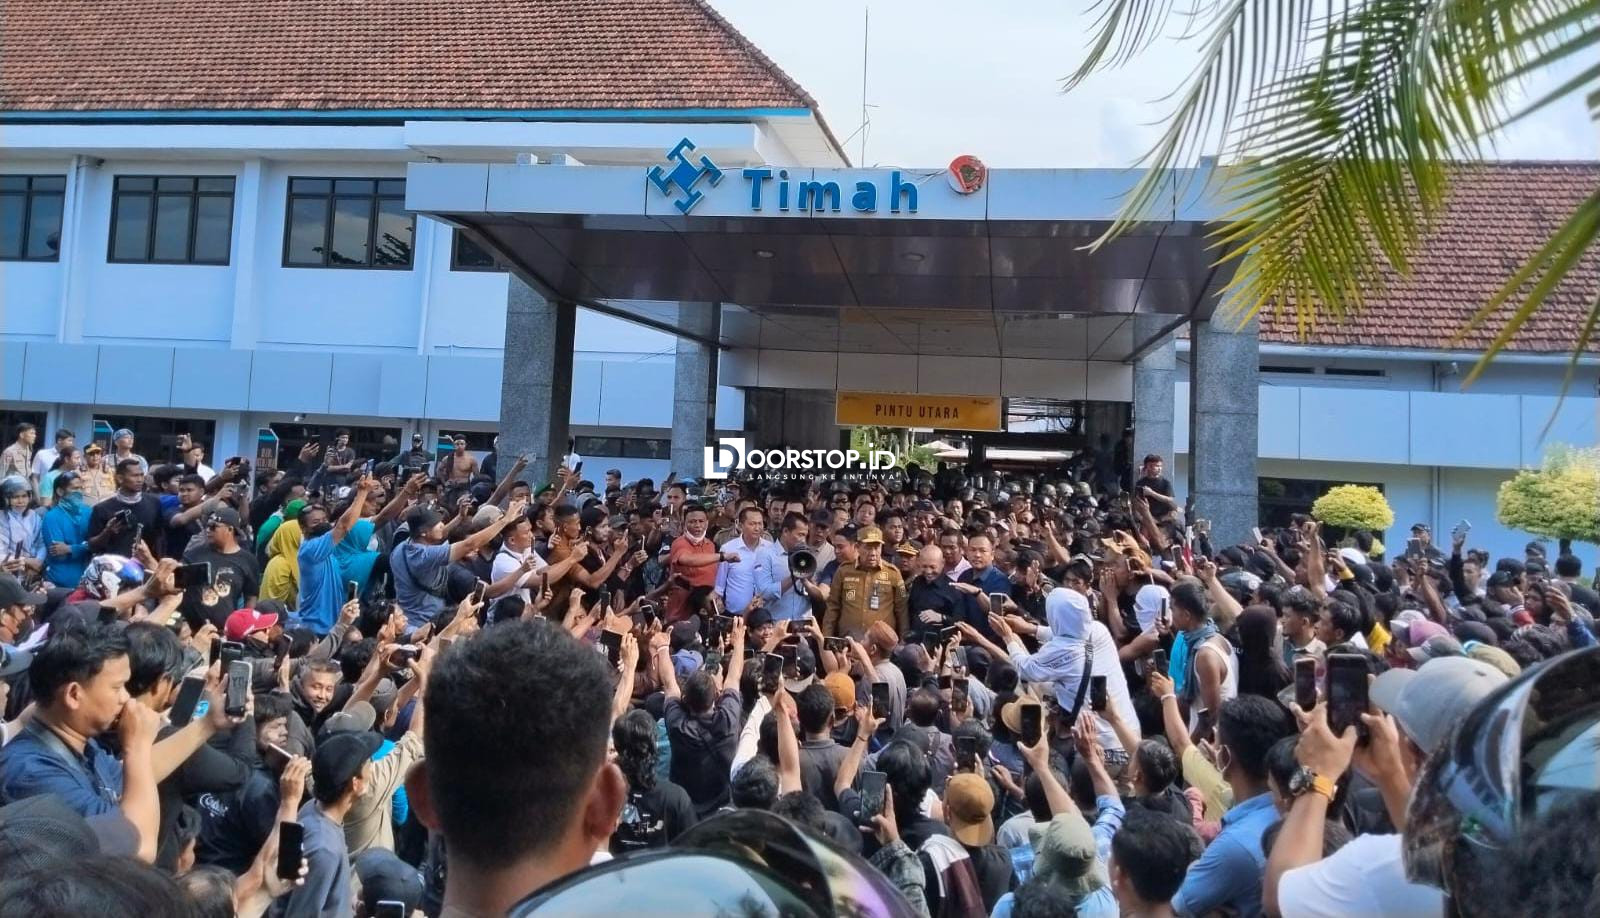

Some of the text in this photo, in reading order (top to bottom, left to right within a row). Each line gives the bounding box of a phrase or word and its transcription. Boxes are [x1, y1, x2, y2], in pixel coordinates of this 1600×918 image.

[742, 168, 919, 214] Timah
[875, 403, 959, 419] PINTU UTARA
